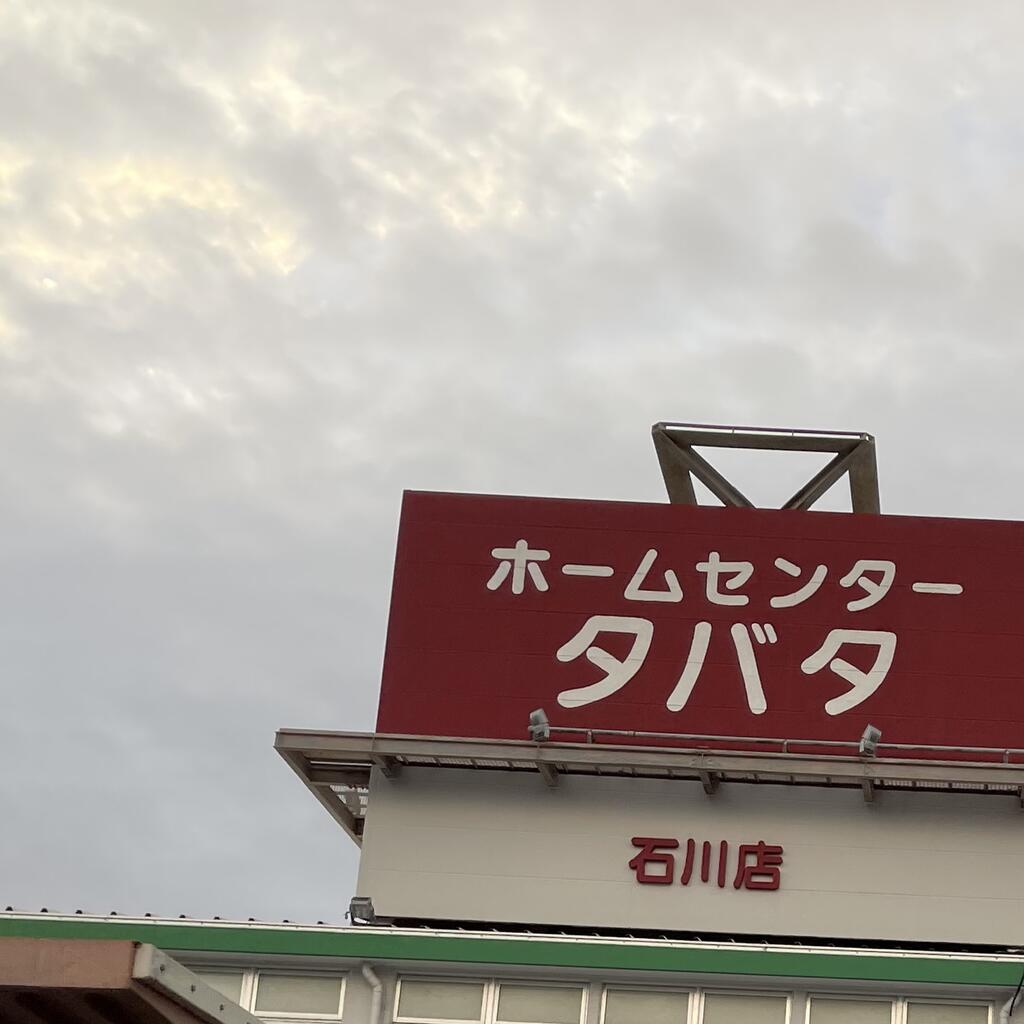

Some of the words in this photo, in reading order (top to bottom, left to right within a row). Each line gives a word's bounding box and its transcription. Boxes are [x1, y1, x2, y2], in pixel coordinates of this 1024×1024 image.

[486, 539, 963, 613] ホームセンター
[556, 614, 897, 716] タバタ
[628, 836, 784, 891] 石川店
